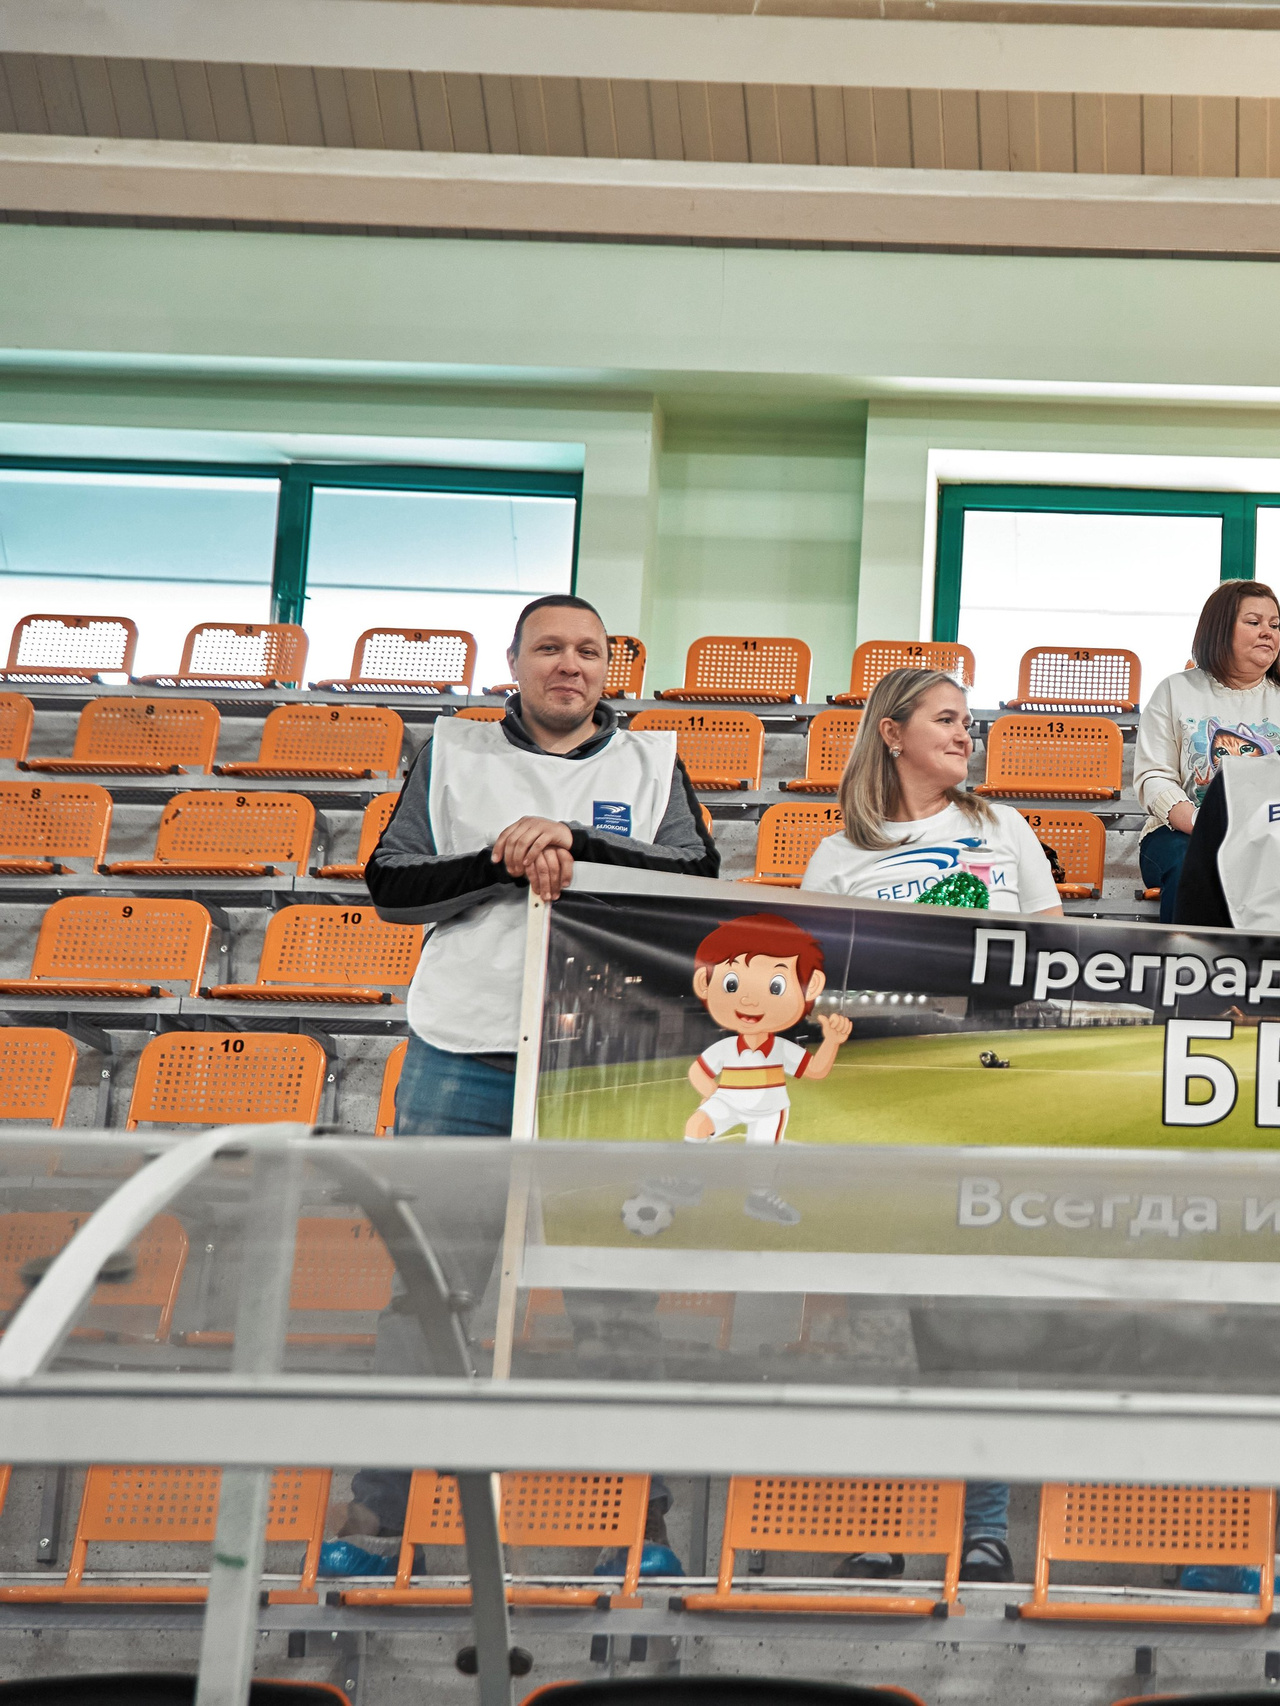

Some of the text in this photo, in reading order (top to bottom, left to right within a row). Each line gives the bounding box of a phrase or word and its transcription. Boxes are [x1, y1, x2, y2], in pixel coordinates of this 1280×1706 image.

[741, 640, 758, 650] 11
[906, 646, 923, 656] 12
[1072, 650, 1090, 661] 13
[145, 703, 155, 715] 8
[329, 710, 340, 721] 9
[687, 716, 705, 727] 11
[1046, 722, 1065, 733] 13
[30, 787, 42, 799] 8
[235, 795, 247, 807] 9
[876, 869, 1008, 902] БЕЛОИ
[121, 905, 133, 918] 9
[340, 912, 362, 925] 10
[221, 1039, 245, 1053] 10
[957, 1175, 1218, 1239] Всегда
